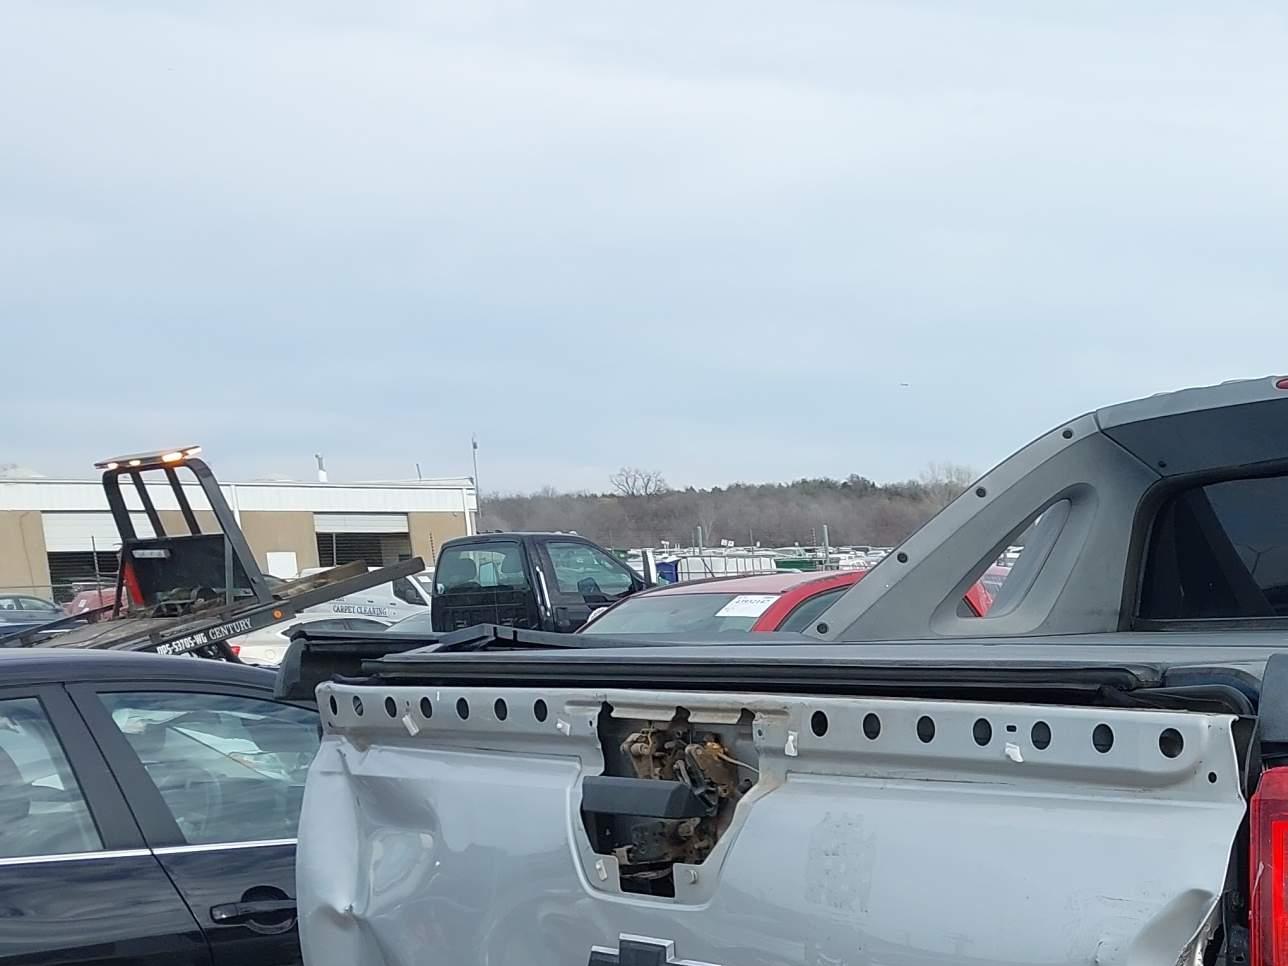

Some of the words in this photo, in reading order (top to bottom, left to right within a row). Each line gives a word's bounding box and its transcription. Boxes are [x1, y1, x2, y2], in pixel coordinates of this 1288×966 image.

[333, 605, 355, 614] CARPET
[357, 606, 387, 616] CLEANING
[208, 618, 252, 640] CENTURY
